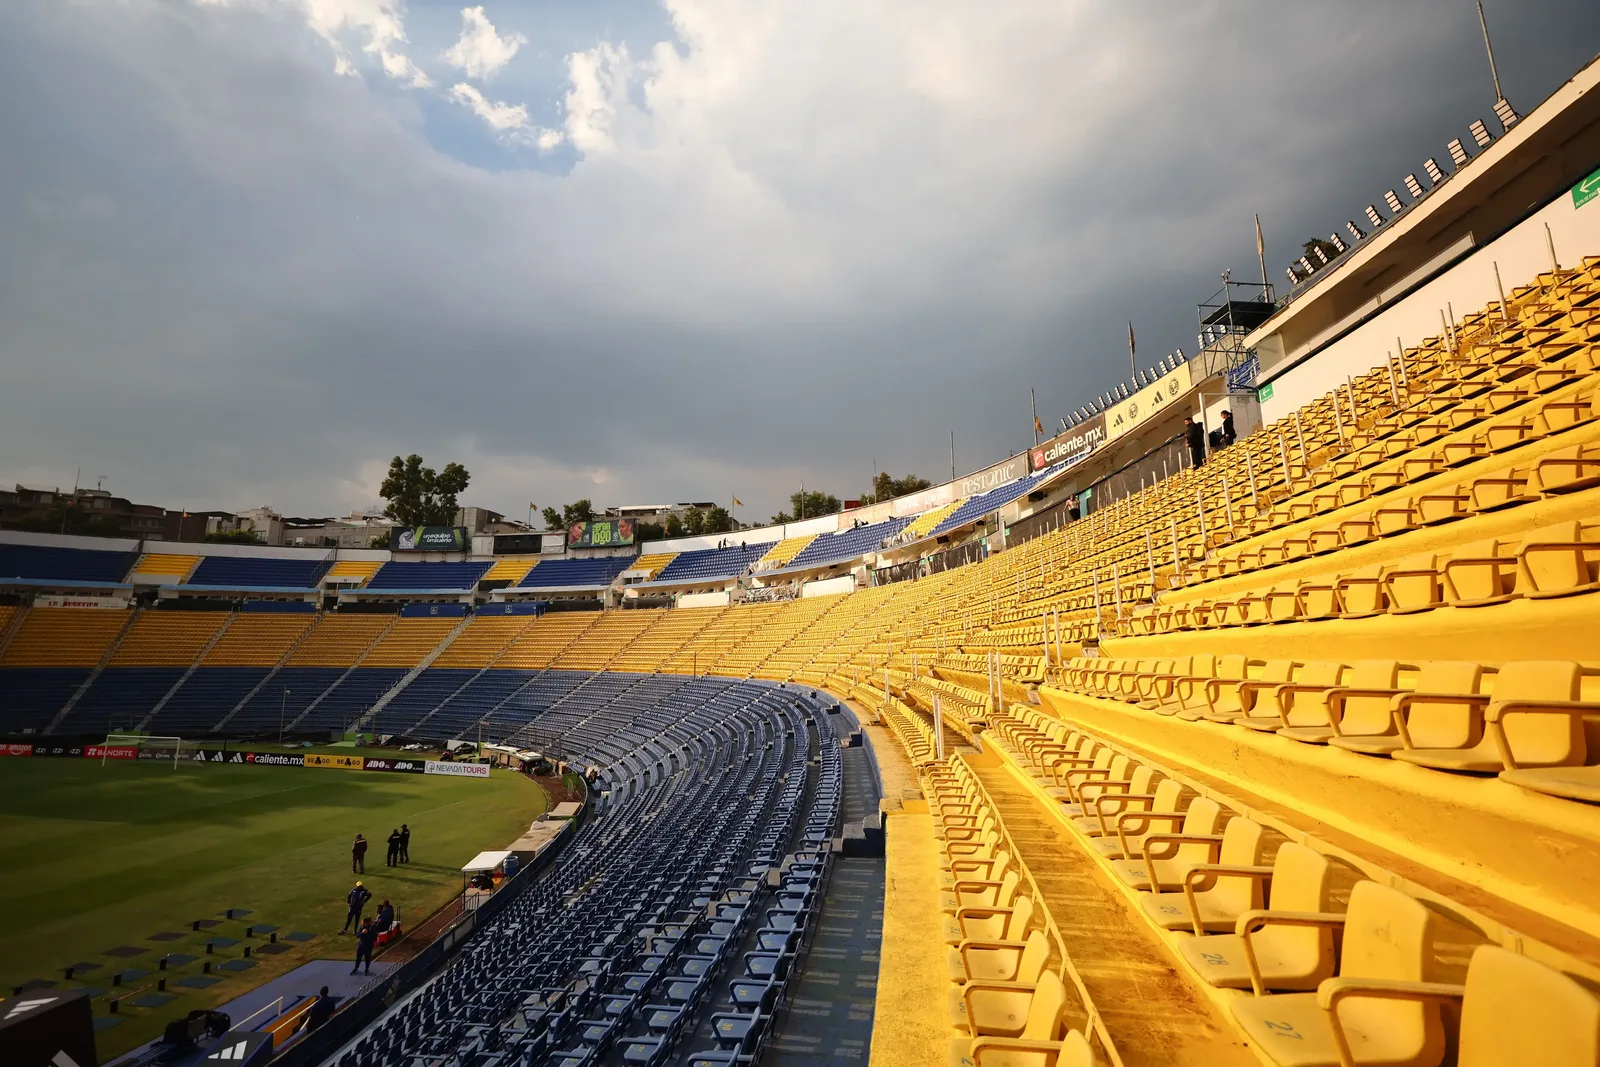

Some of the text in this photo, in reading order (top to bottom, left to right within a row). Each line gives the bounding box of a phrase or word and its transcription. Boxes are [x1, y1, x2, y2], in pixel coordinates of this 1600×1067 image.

[1044, 425, 1103, 462] caliente.mx
[97, 749, 133, 757] BANORTE
[254, 754, 304, 766] caliente.mx
[366, 760, 385, 769] ADO
[394, 761, 413, 771] ADO
[1200, 953, 1229, 966] 28
[1264, 1020, 1306, 1041] 27
